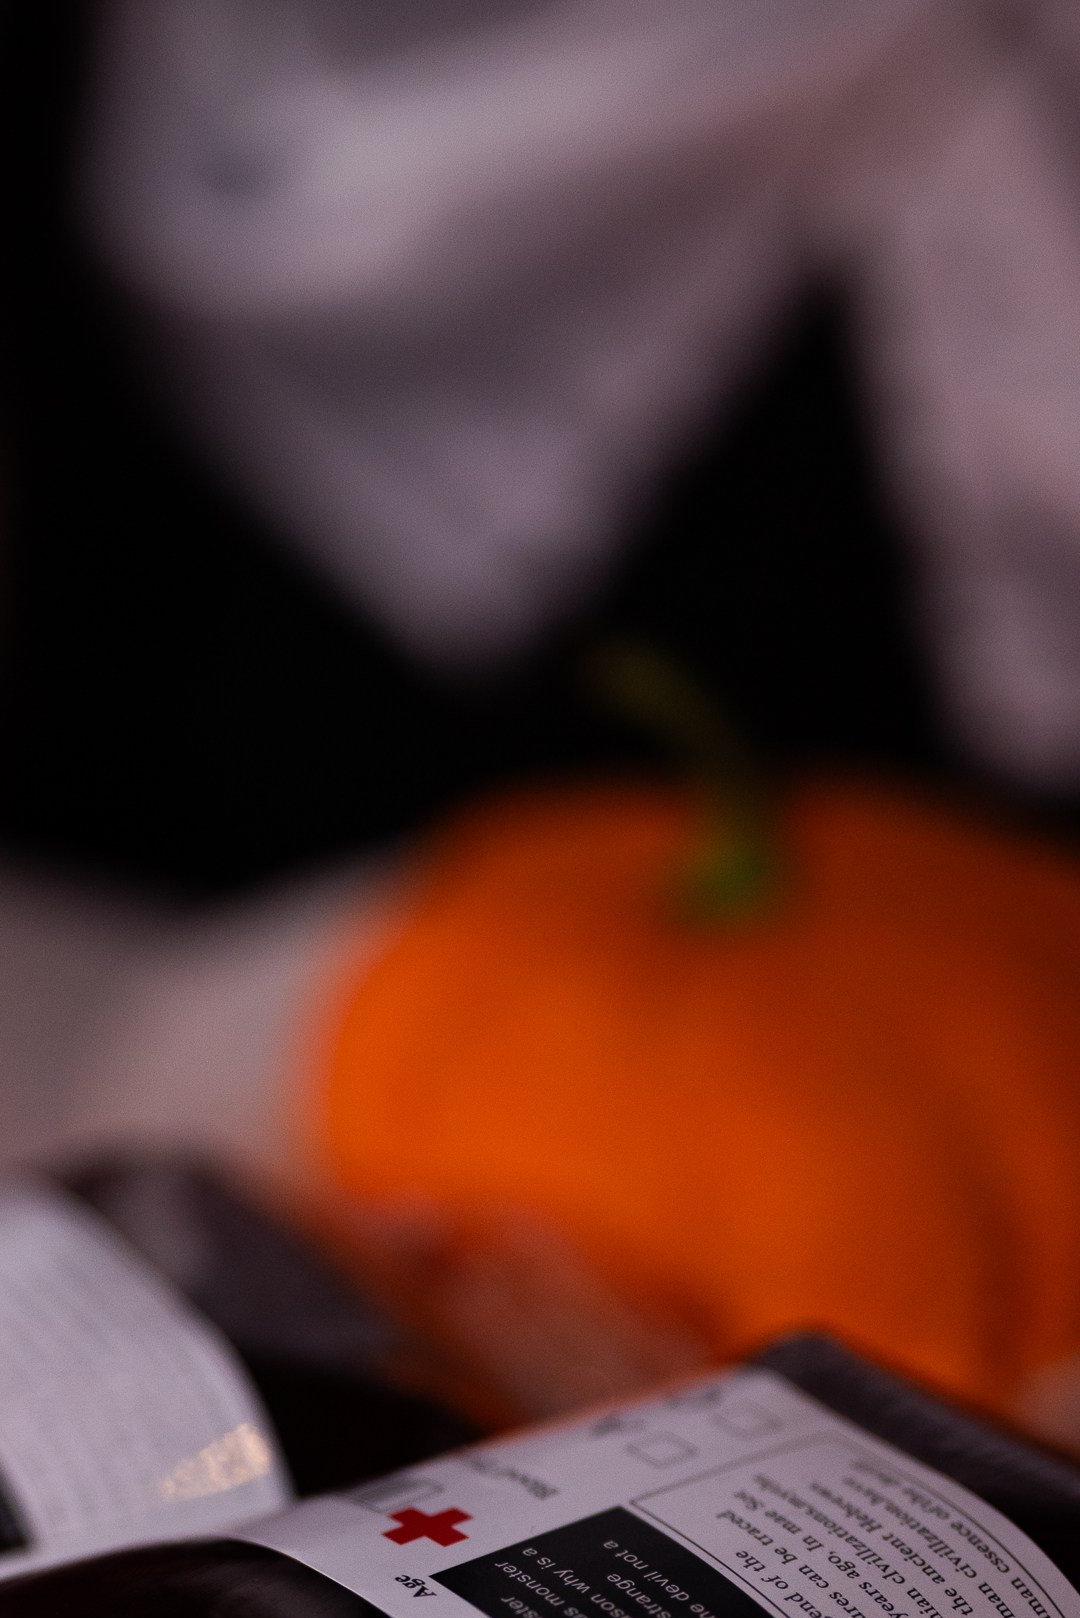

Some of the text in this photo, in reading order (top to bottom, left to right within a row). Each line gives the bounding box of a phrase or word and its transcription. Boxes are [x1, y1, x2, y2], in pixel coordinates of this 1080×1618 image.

[717, 1511, 774, 1546] traced
[522, 1548, 538, 1556] a
[603, 1540, 619, 1549] a
[803, 1535, 824, 1552] In
[537, 1557, 555, 1569] is
[615, 1550, 648, 1570] not
[736, 1551, 765, 1572] the
[774, 1547, 797, 1565] be
[828, 1551, 860, 1579] ago,
[883, 1534, 945, 1584] ancient
[395, 1575, 436, 1597] Age
[495, 1562, 564, 1606] monster
[553, 1570, 590, 1593] why
[643, 1571, 689, 1601] devil
[761, 1576, 788, 1589] of
[799, 1565, 829, 1588] can
[945, 1588, 973, 1615] the
